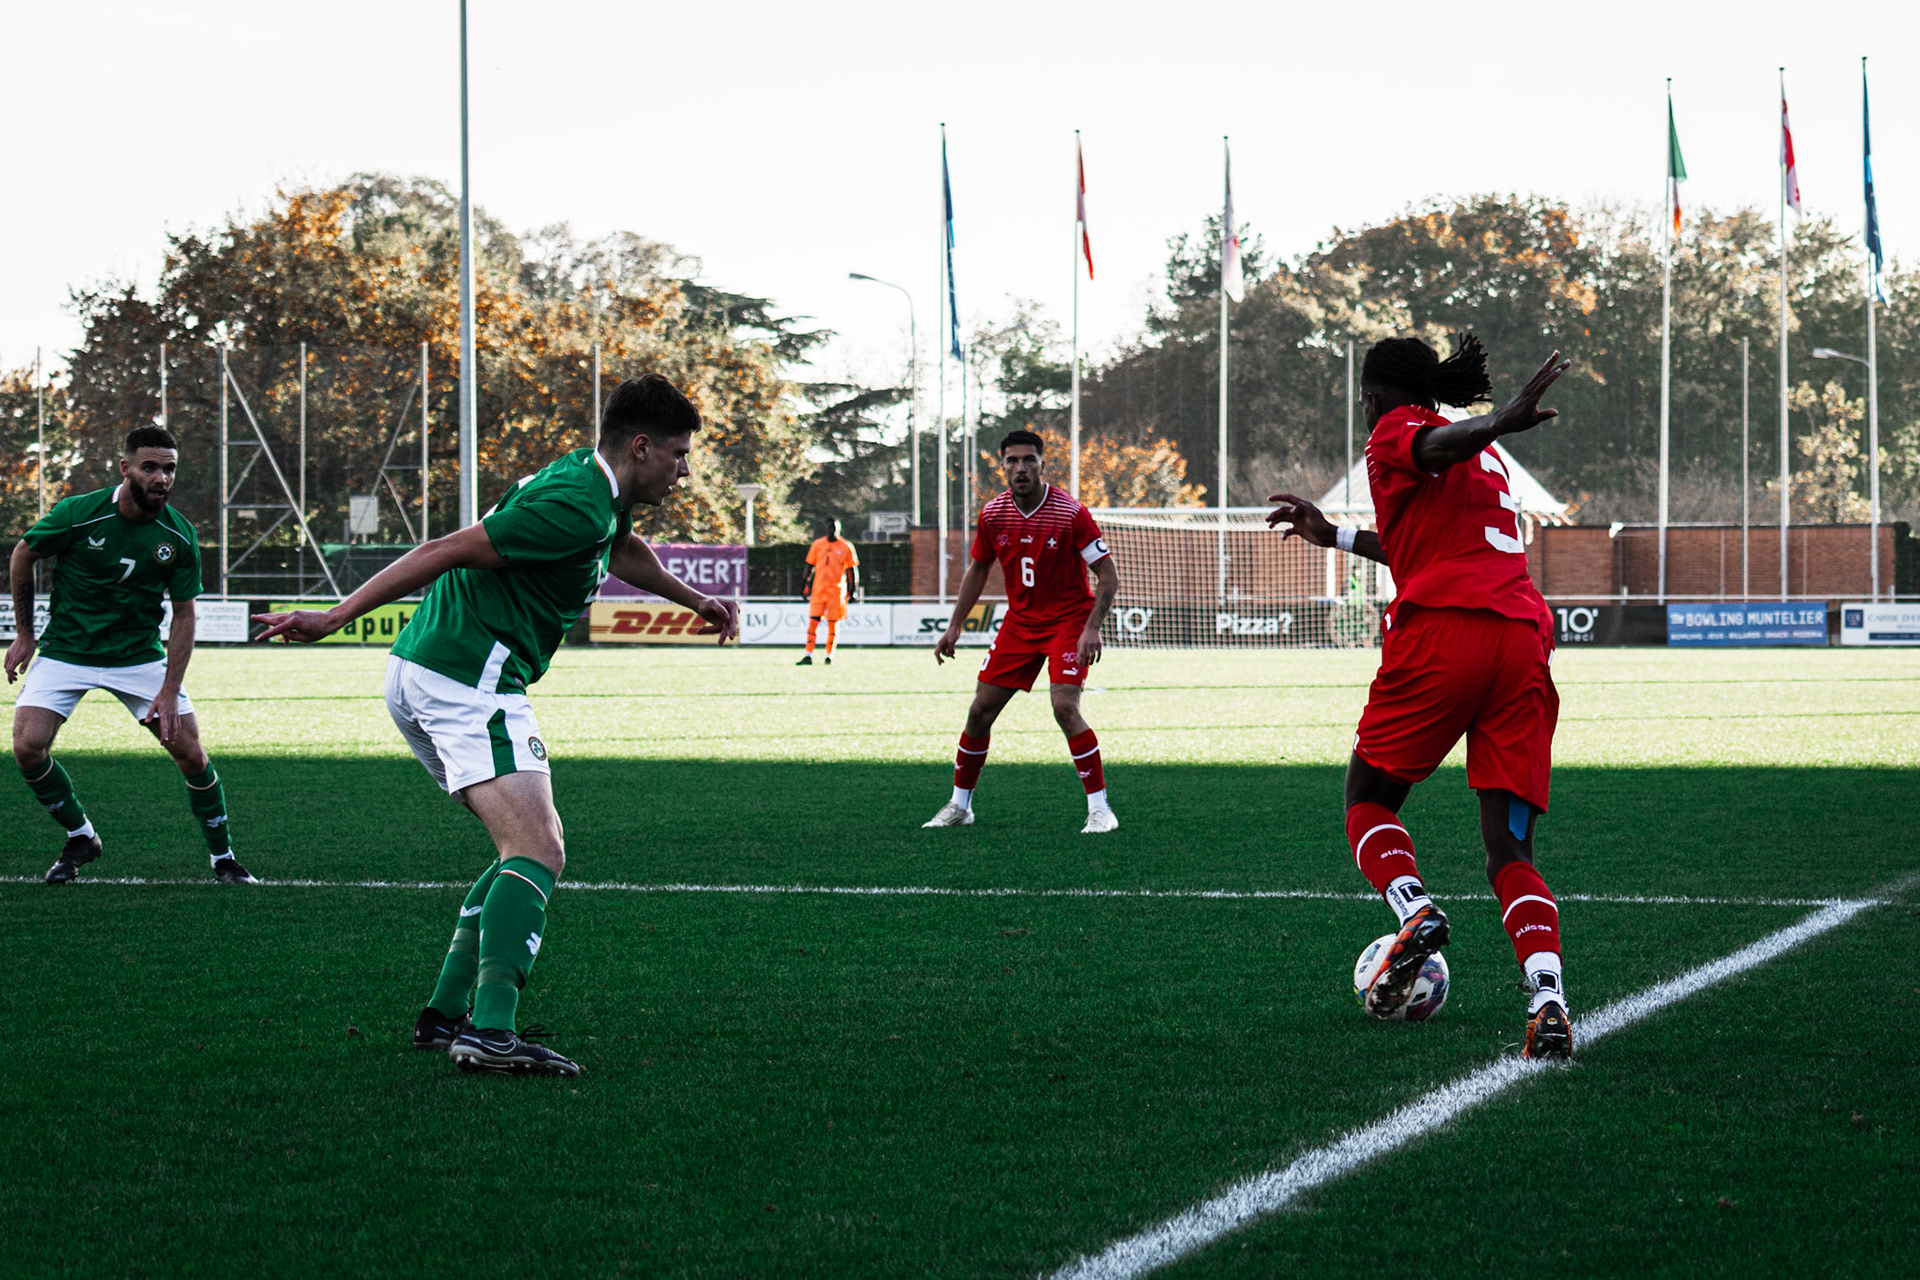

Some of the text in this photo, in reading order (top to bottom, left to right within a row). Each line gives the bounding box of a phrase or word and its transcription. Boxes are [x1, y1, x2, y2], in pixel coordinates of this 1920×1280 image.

[1480, 450, 1525, 554] 3
[116, 557, 136, 584] 7
[667, 557, 746, 584] EXERT
[1020, 556, 1035, 588] 6
[746, 614, 767, 627] LM
[1215, 612, 1293, 635] Pizza?
[1685, 610, 1824, 626] BOWLING MUNTELIER
[1561, 632, 1594, 642] dieci
[1515, 923, 1552, 939] suisse
